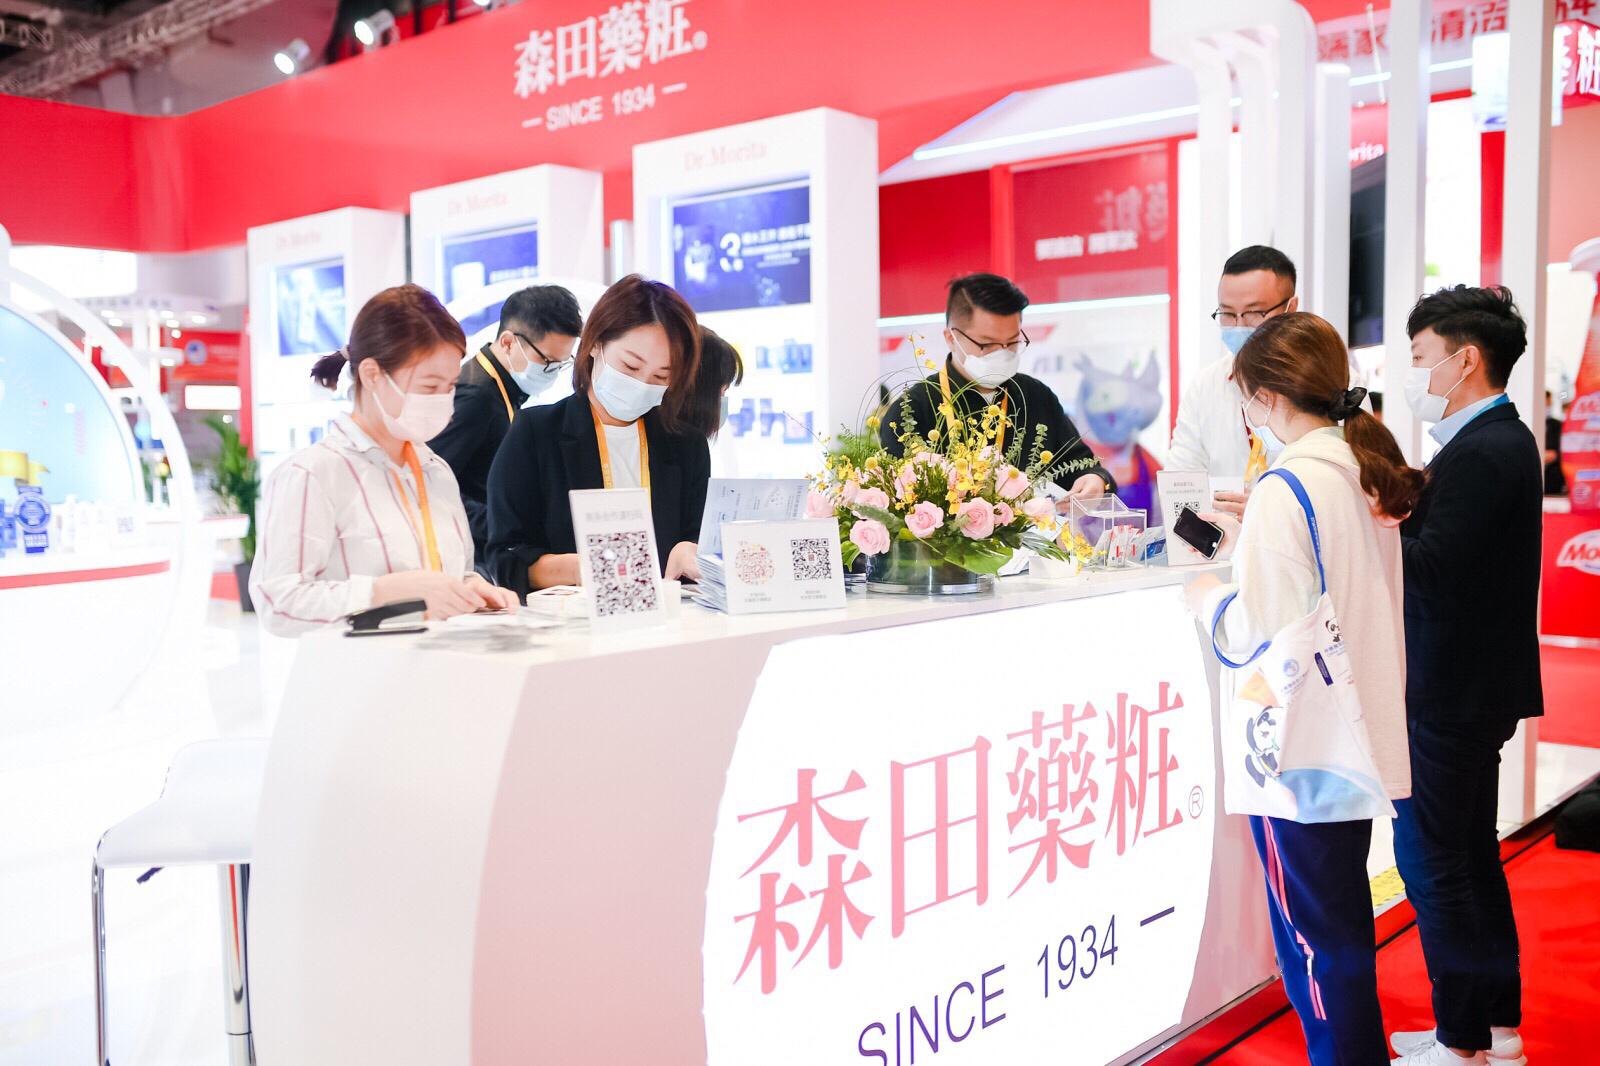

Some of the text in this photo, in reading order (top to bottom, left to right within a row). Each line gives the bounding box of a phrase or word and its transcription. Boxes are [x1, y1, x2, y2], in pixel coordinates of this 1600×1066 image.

[513, 0, 693, 98] 森田藥粧
[545, 84, 656, 131] SINCE 1934
[1350, 142, 1385, 162] rita
[733, 681, 1184, 995] 森田藥粧
[858, 914, 1119, 1066] SINCE 1934
